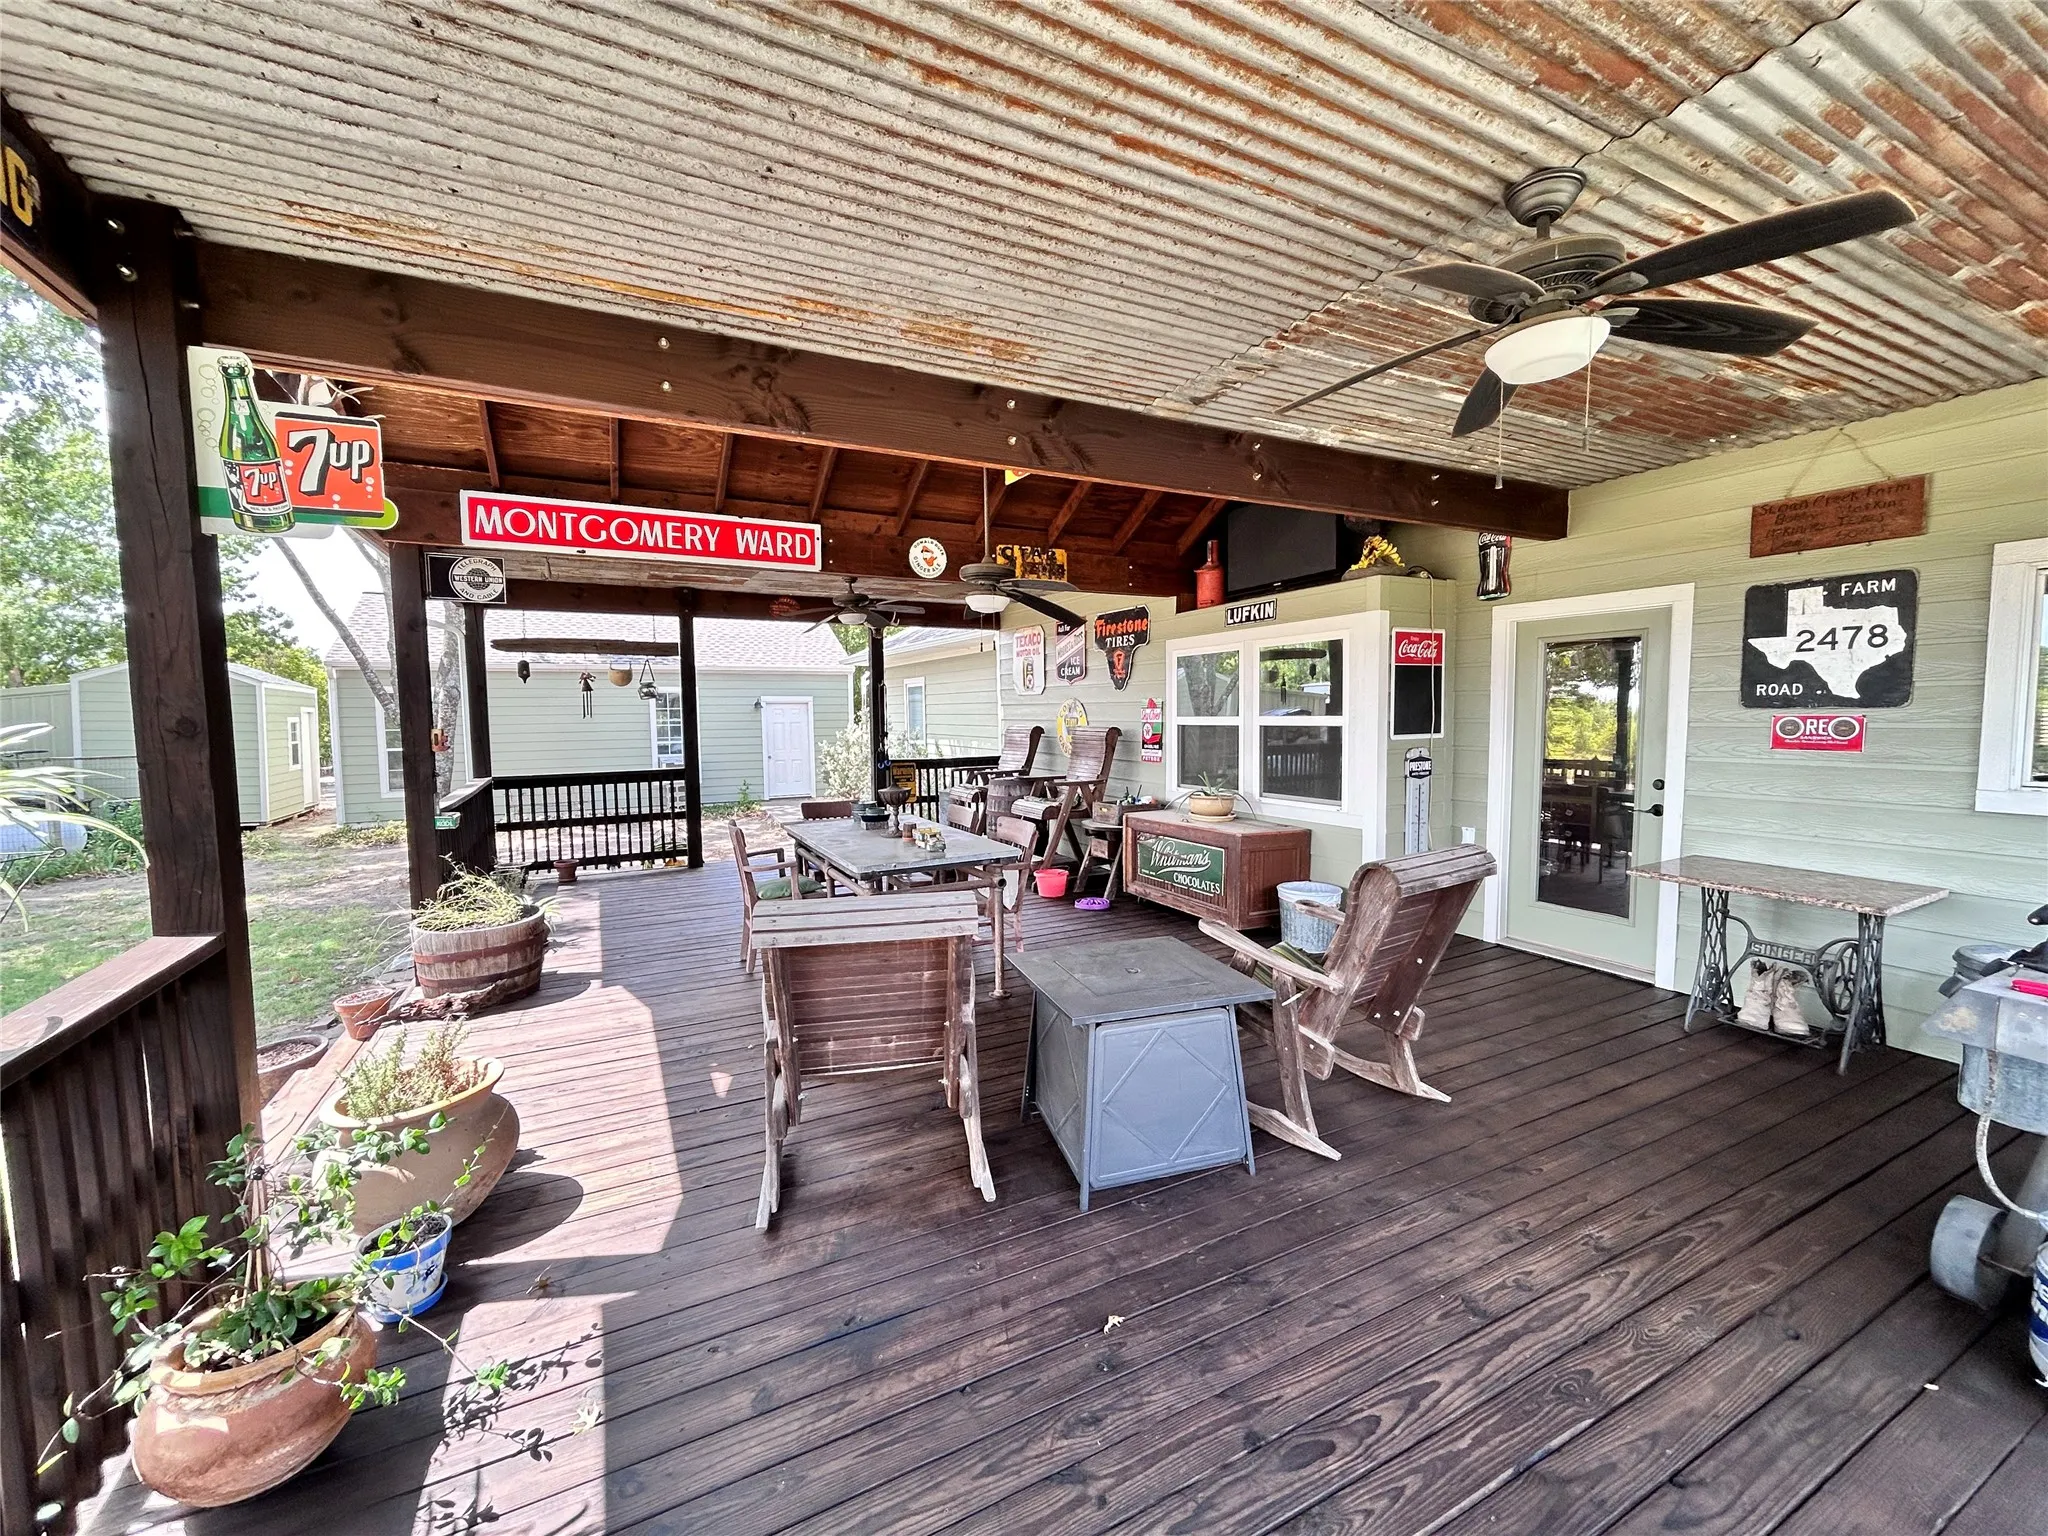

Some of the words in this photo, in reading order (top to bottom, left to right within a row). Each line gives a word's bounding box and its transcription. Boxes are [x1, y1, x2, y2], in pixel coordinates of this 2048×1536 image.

[474, 504, 721, 552] MONTGOMERY
[735, 527, 812, 559] WARD
[457, 558, 497, 572] TELEGRAPH
[454, 575, 483, 583] WESTERN
[1840, 577, 1897, 597] FARM
[1227, 601, 1274, 624] LUFKIN
[1094, 618, 1148, 639] Firestone
[1015, 632, 1041, 648] TEXACO
[1105, 634, 1135, 648] TIRES
[1795, 623, 1889, 653] 2478
[1032, 647, 1041, 656] OIL
[1398, 639, 1439, 658] Coca-Cola
[1070, 656, 1080, 666] ICE
[1060, 666, 1081, 677] CREAM
[1755, 683, 1804, 697] ROAD
[1776, 716, 1860, 740] OREO
[1410, 761, 1431, 771] PRESTONE
[1173, 872, 1221, 894] CHOCOLATES
